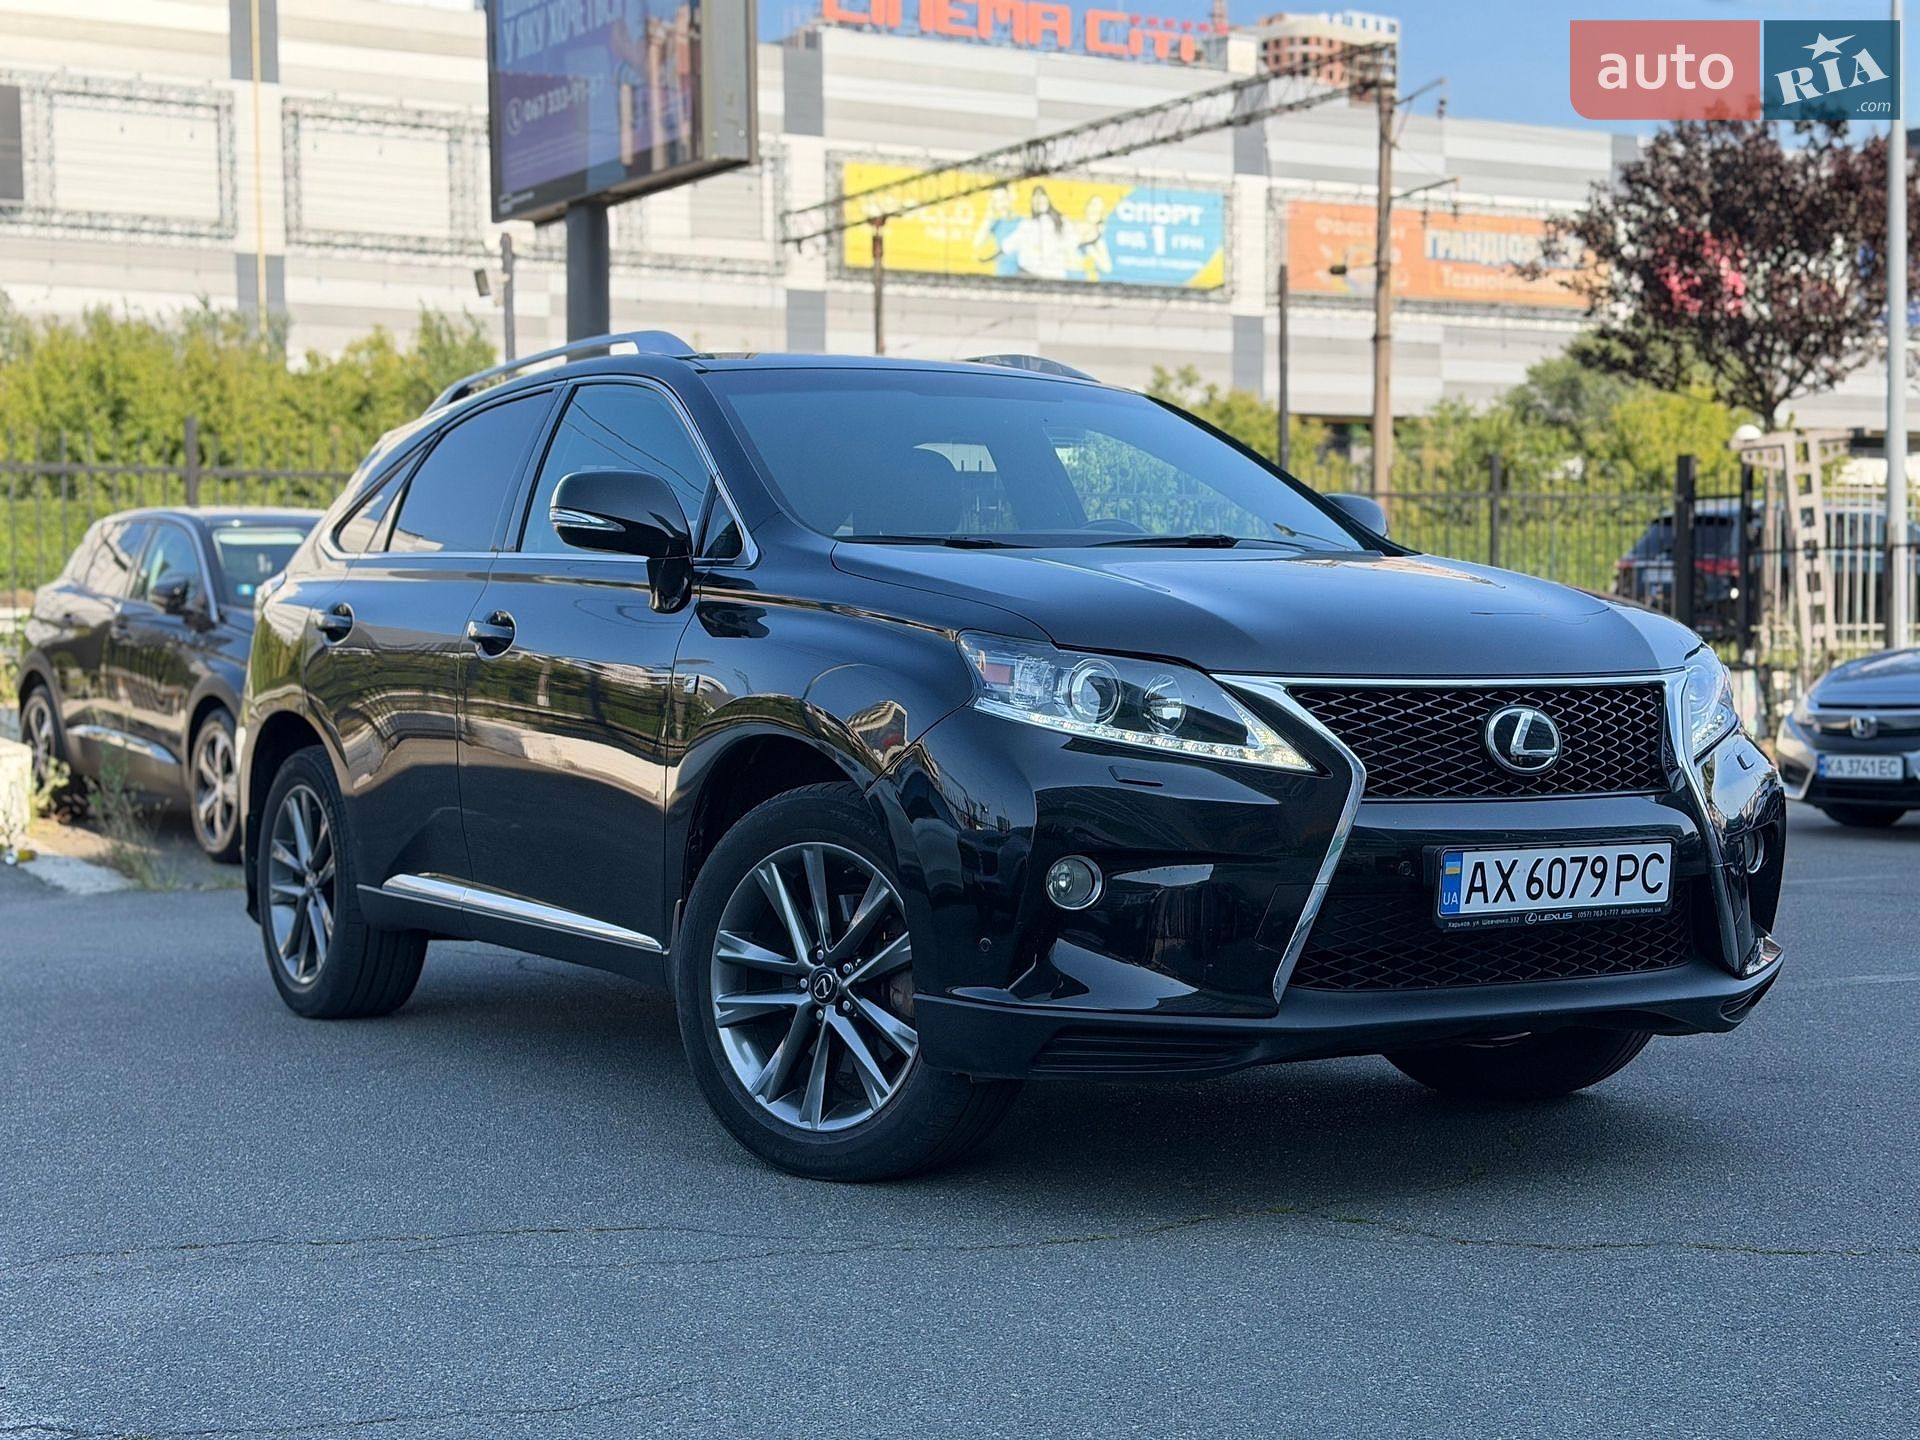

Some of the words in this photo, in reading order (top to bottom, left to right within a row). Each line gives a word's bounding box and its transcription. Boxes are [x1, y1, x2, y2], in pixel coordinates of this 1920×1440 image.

[1115, 200, 1205, 227] СПОРТ
[1152, 225, 1166, 256] 1
[1847, 758, 1876, 775] 3741
[1879, 759, 1900, 776] EC
[1464, 857, 1519, 905] AX
[1525, 855, 1609, 901] 6079
[1614, 852, 1666, 897] PC
[1442, 894, 1459, 906] UA
[1538, 911, 1573, 922] LEXUS
